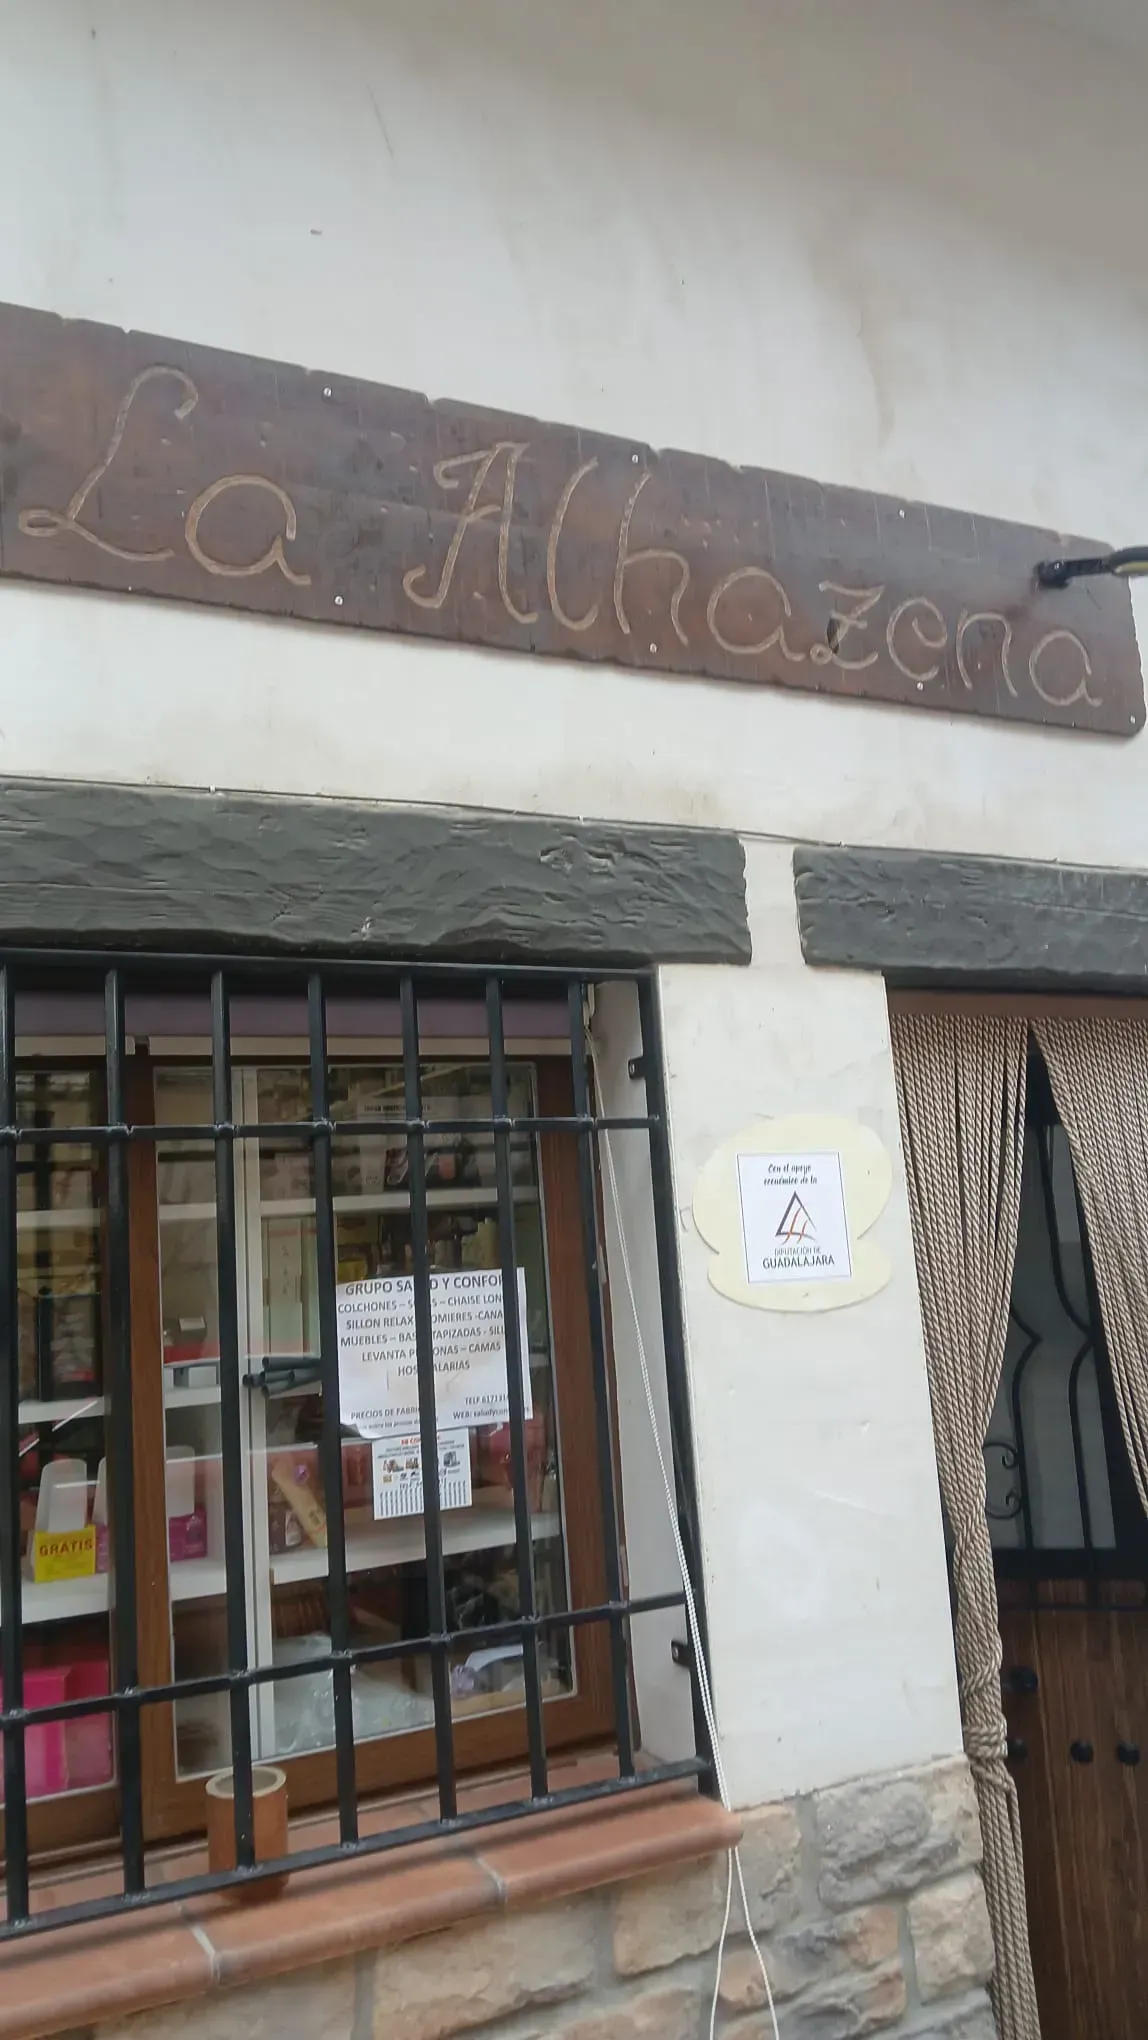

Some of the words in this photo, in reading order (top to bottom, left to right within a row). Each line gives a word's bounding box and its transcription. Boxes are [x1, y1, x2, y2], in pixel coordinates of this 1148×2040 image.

[18, 363, 311, 585] La
[403, 442, 1101, 706] Alhazena
[762, 1254, 835, 1269] GUADALAJARA
[345, 1280, 393, 1296] GRUPO
[396, 1278, 439, 1293] SAD
[442, 1277, 450, 1290] Y
[453, 1274, 502, 1289] CONFO
[338, 1300, 397, 1314] COLCHONES
[447, 1294, 480, 1306] CHAISE
[483, 1293, 502, 1305] LON
[346, 1318, 380, 1330] SILLON
[383, 1315, 414, 1328] RELAX
[431, 1311, 472, 1323] OMIERES
[340, 1334, 388, 1347] MUEBLES
[489, 1325, 505, 1336] SILL
[362, 1349, 406, 1362] LEVANTA
[409, 1344, 459, 1359] PONAS
[468, 1341, 501, 1353] CAMAS
[398, 1360, 471, 1377] HOSALARIAS
[351, 1408, 383, 1420] PRECIOS
[384, 1408, 394, 1417] DE
[395, 1406, 419, 1417] FABRI
[39, 1537, 93, 1558] GRATIS
